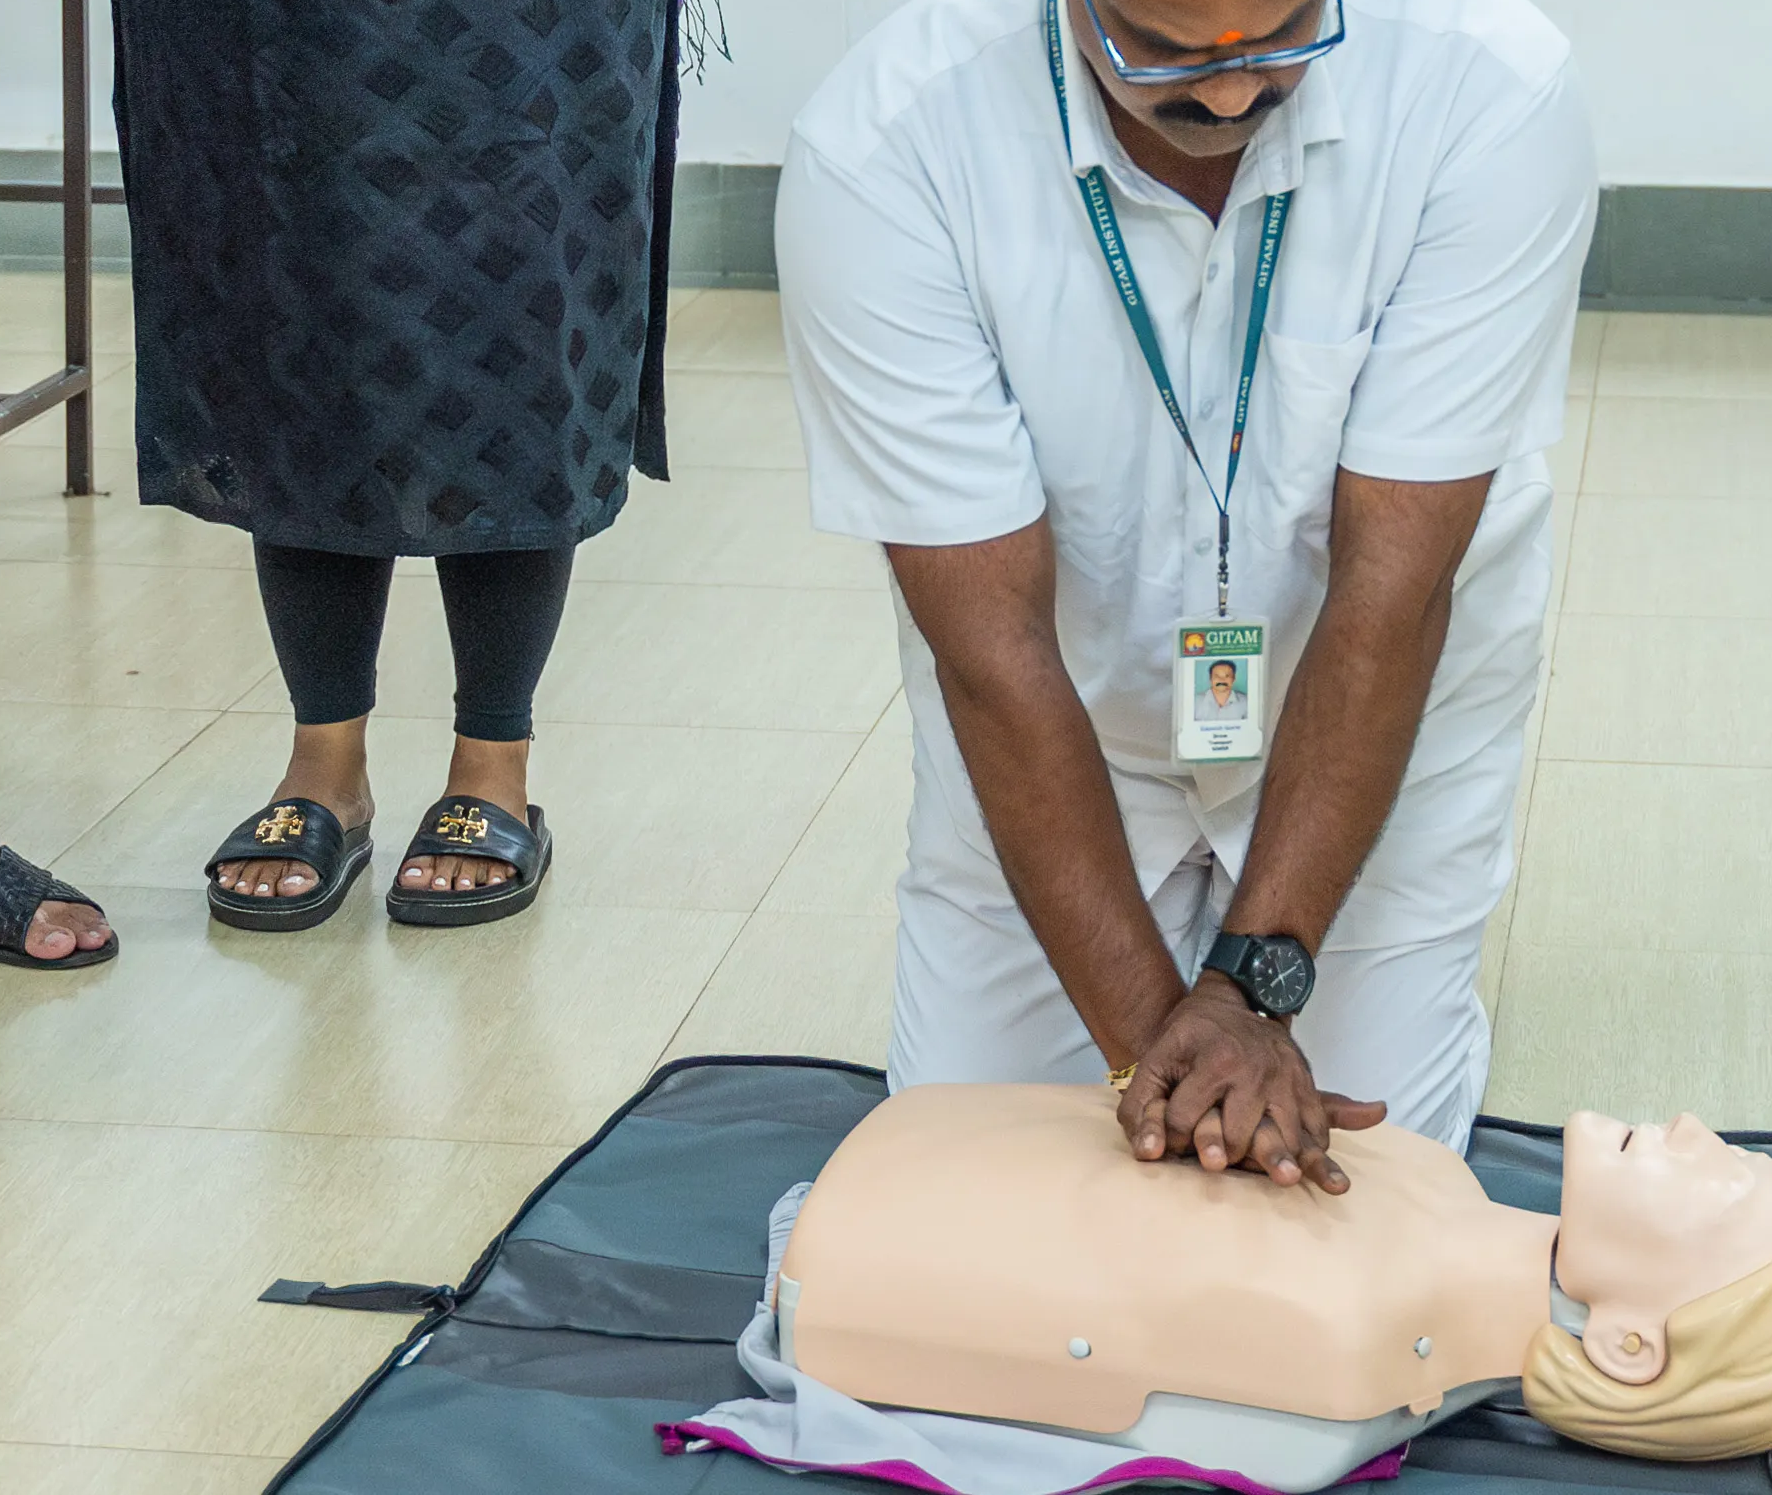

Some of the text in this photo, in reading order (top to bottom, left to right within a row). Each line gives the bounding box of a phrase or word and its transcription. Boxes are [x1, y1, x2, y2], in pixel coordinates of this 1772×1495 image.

[1087, 174, 1139, 306] GITAM INSTITUTE
[1257, 238, 1276, 288] GITAM
[1236, 375, 1251, 424] GITAM
[1205, 628, 1259, 645] GITAM
